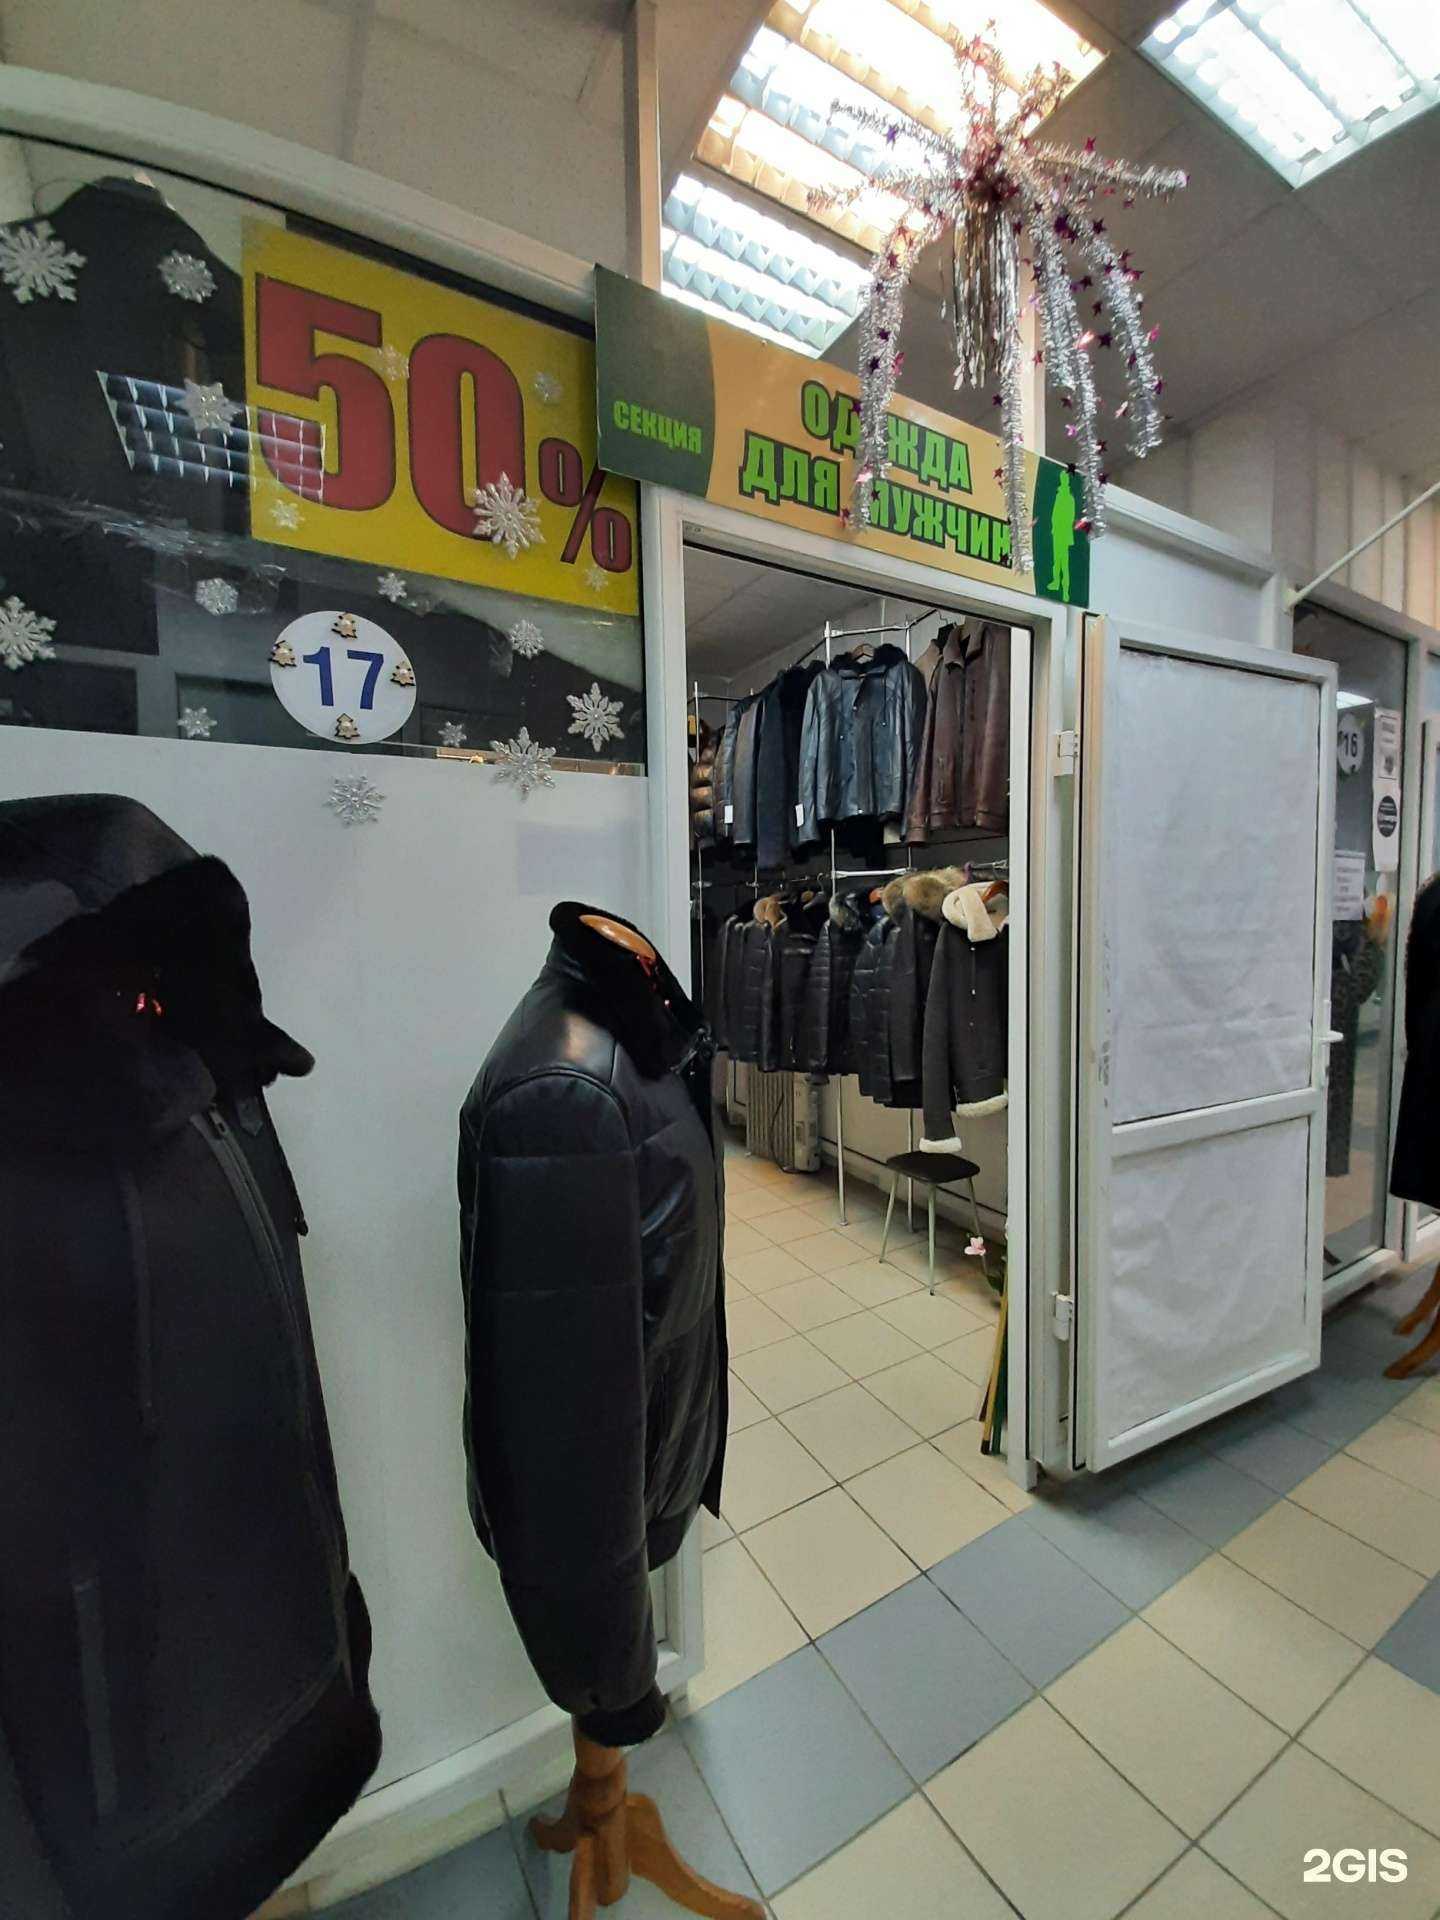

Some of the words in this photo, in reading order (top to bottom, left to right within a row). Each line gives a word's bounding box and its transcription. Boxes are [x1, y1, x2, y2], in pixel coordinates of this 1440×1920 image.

[256, 273, 633, 573] 50%
[613, 400, 702, 454] СЕКЦИЯ
[802, 380, 973, 495] ОДЖДА
[739, 429, 841, 516] ДЛЯ
[302, 646, 385, 711] 17
[1343, 732, 1359, 758] 16
